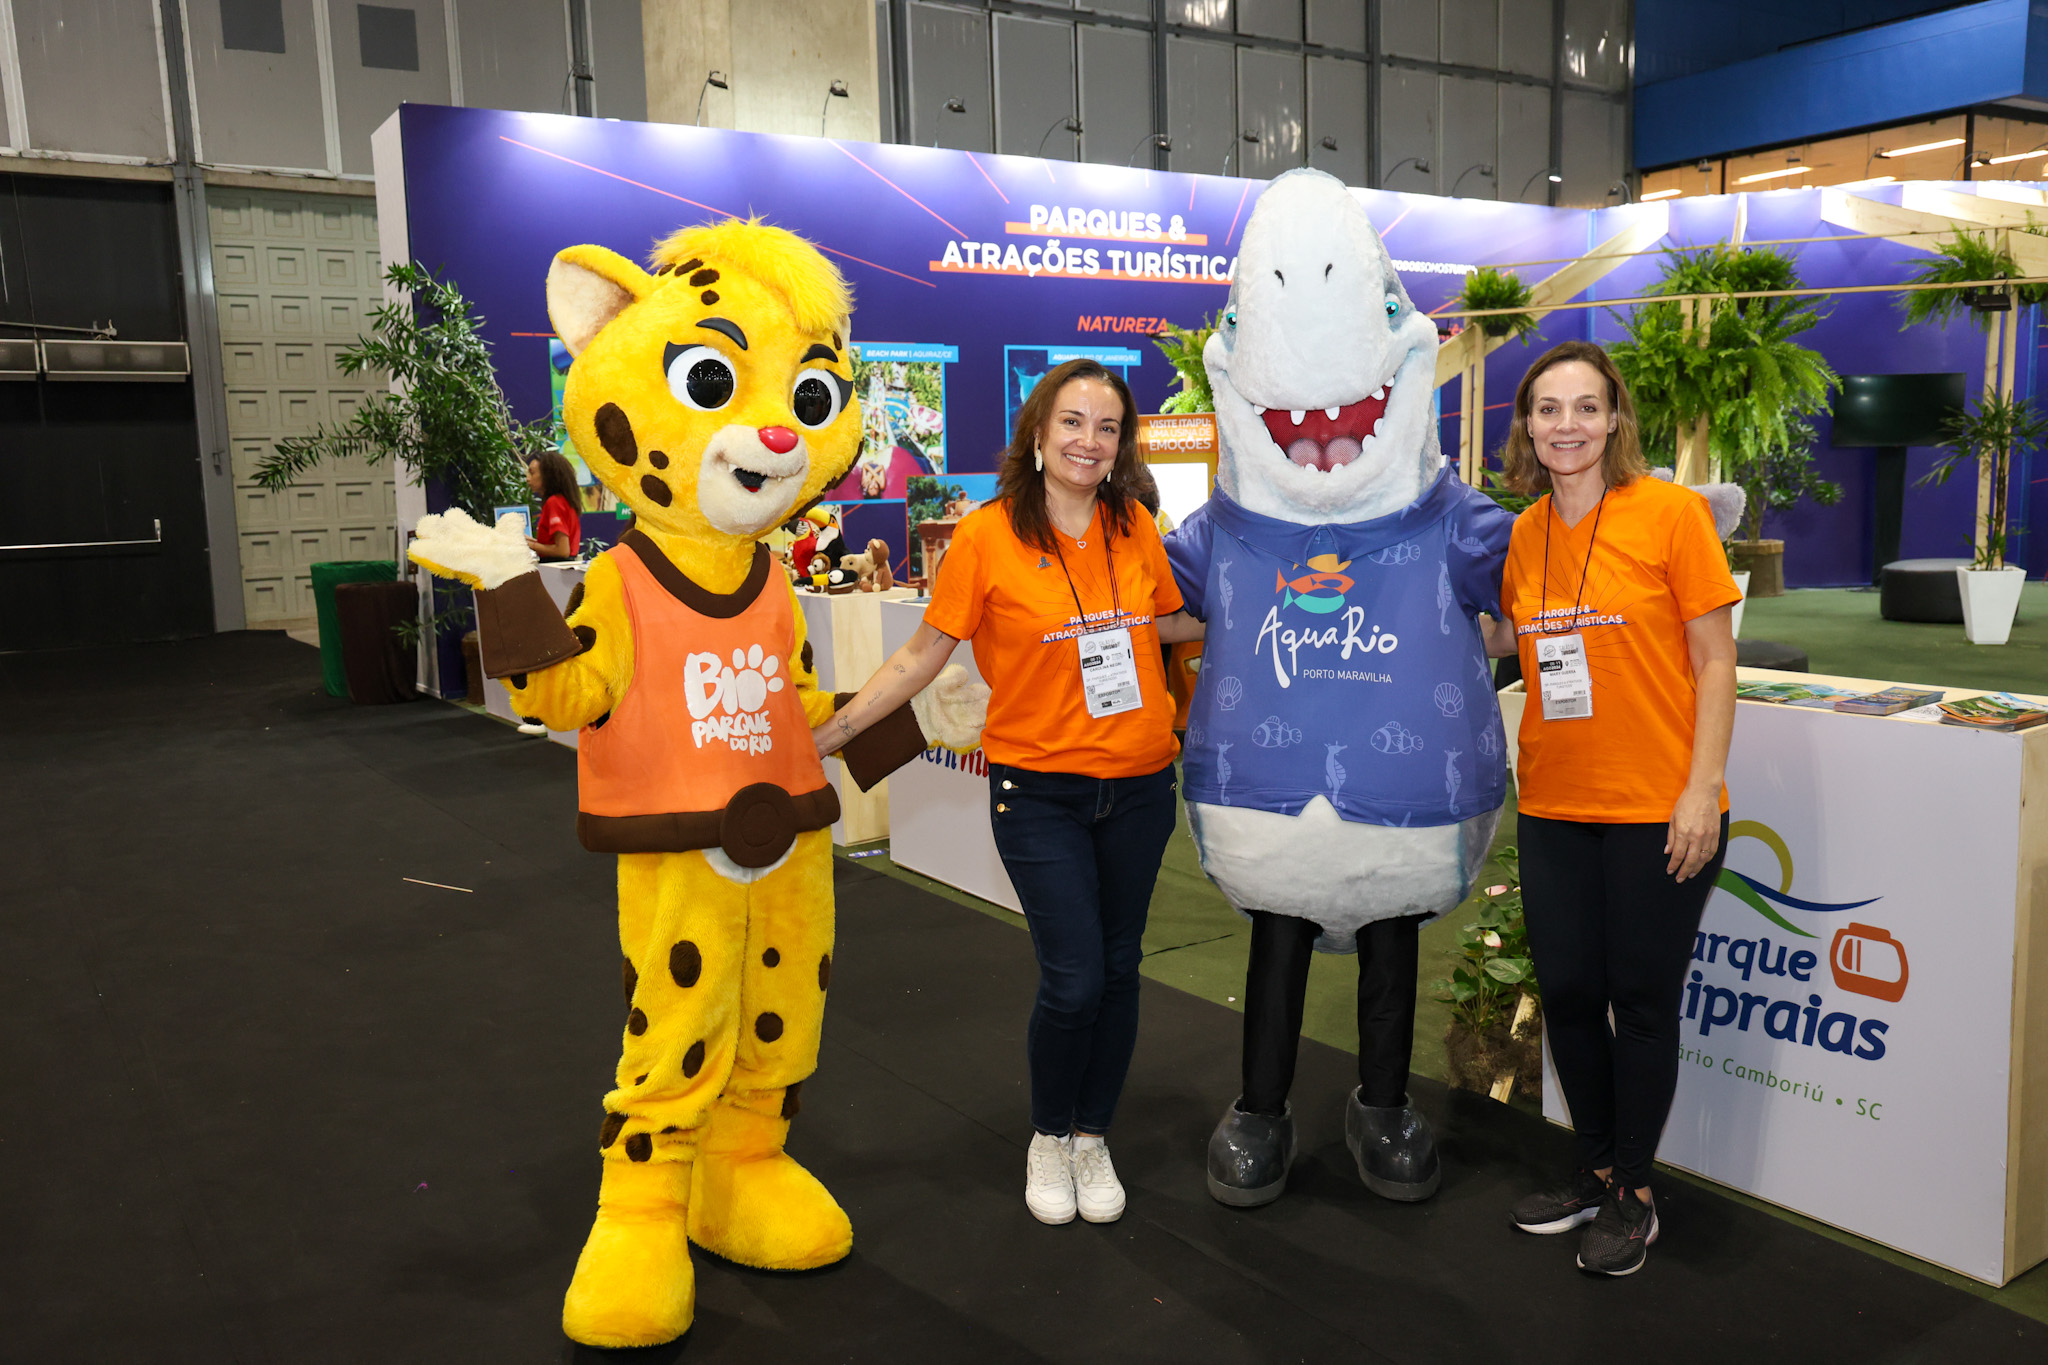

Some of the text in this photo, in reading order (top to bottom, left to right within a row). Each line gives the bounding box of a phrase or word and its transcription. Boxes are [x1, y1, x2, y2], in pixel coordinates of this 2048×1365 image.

[1030, 204, 1187, 241] PARQUES &
[941, 239, 1100, 277] ATRAÇÕES
[1077, 315, 1168, 334] NATUREZA
[866, 350, 889, 358] BEACH
[890, 350, 909, 358] PARK
[1149, 418, 1211, 429] VISITE ITAIPU:
[1149, 427, 1211, 438] UMA USINA DE
[1149, 435, 1211, 453] EMOÇÕES
[1069, 609, 1115, 625] PARQUES
[1538, 604, 1591, 619] PARQUES &
[1303, 669, 1392, 683] PORTO MARAVILHA
[691, 710, 772, 749] PARQUE
[730, 735, 772, 756] DO RIO
[1690, 930, 1817, 982] arque
[1680, 970, 1890, 1061] ipraias
[1722, 1058, 1824, 1102] Camboriú
[1856, 1098, 1882, 1120] SC
